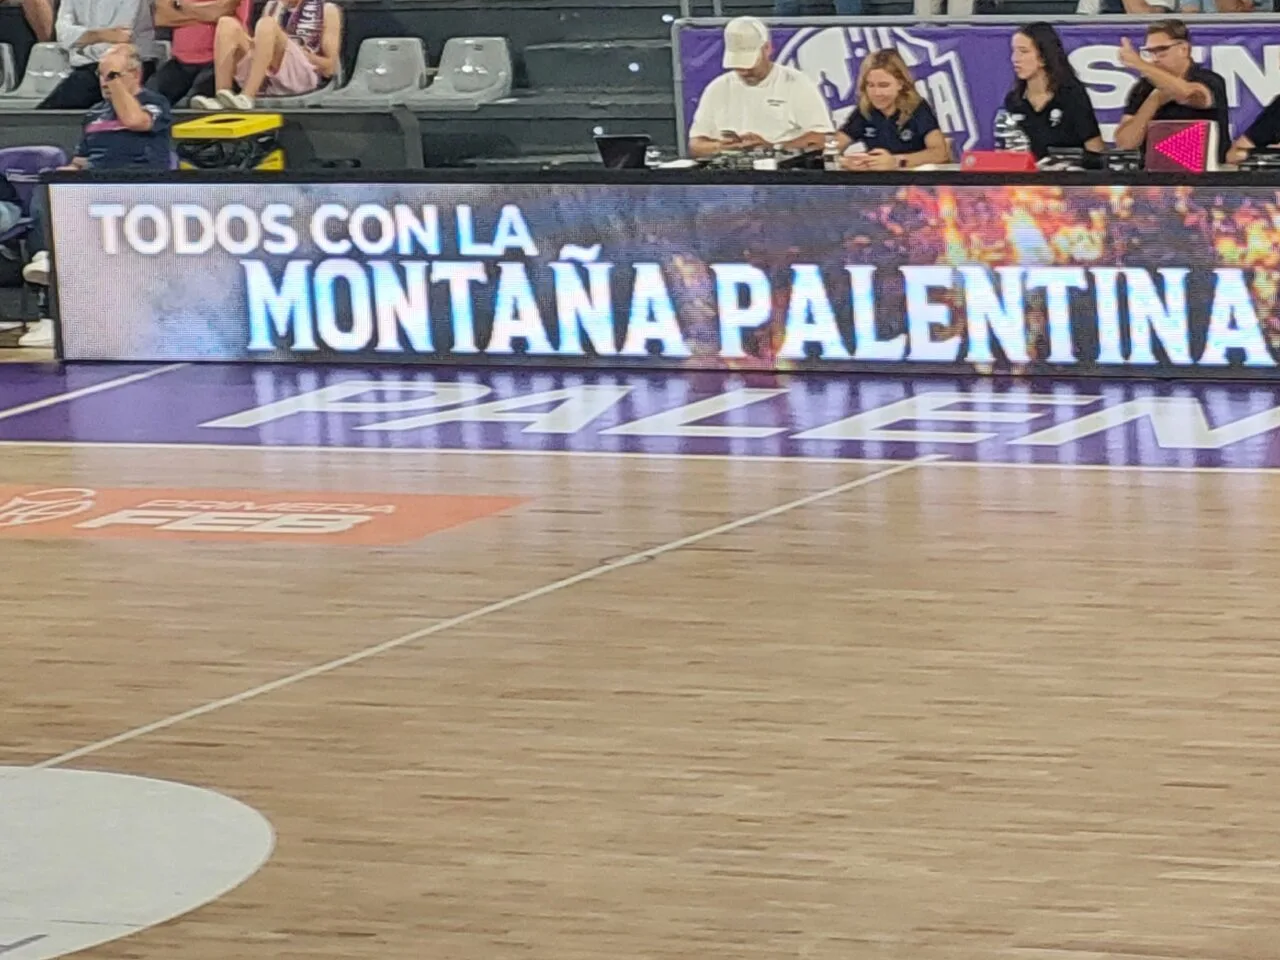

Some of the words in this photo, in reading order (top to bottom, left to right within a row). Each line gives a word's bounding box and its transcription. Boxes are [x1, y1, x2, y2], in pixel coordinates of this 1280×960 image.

[88, 203, 297, 256] TODOS
[310, 203, 441, 256] CON
[456, 205, 539, 257] LA
[240, 242, 693, 359] MONTAÑA
[709, 262, 1279, 368] PALENTINA
[72, 509, 375, 534] FEB
